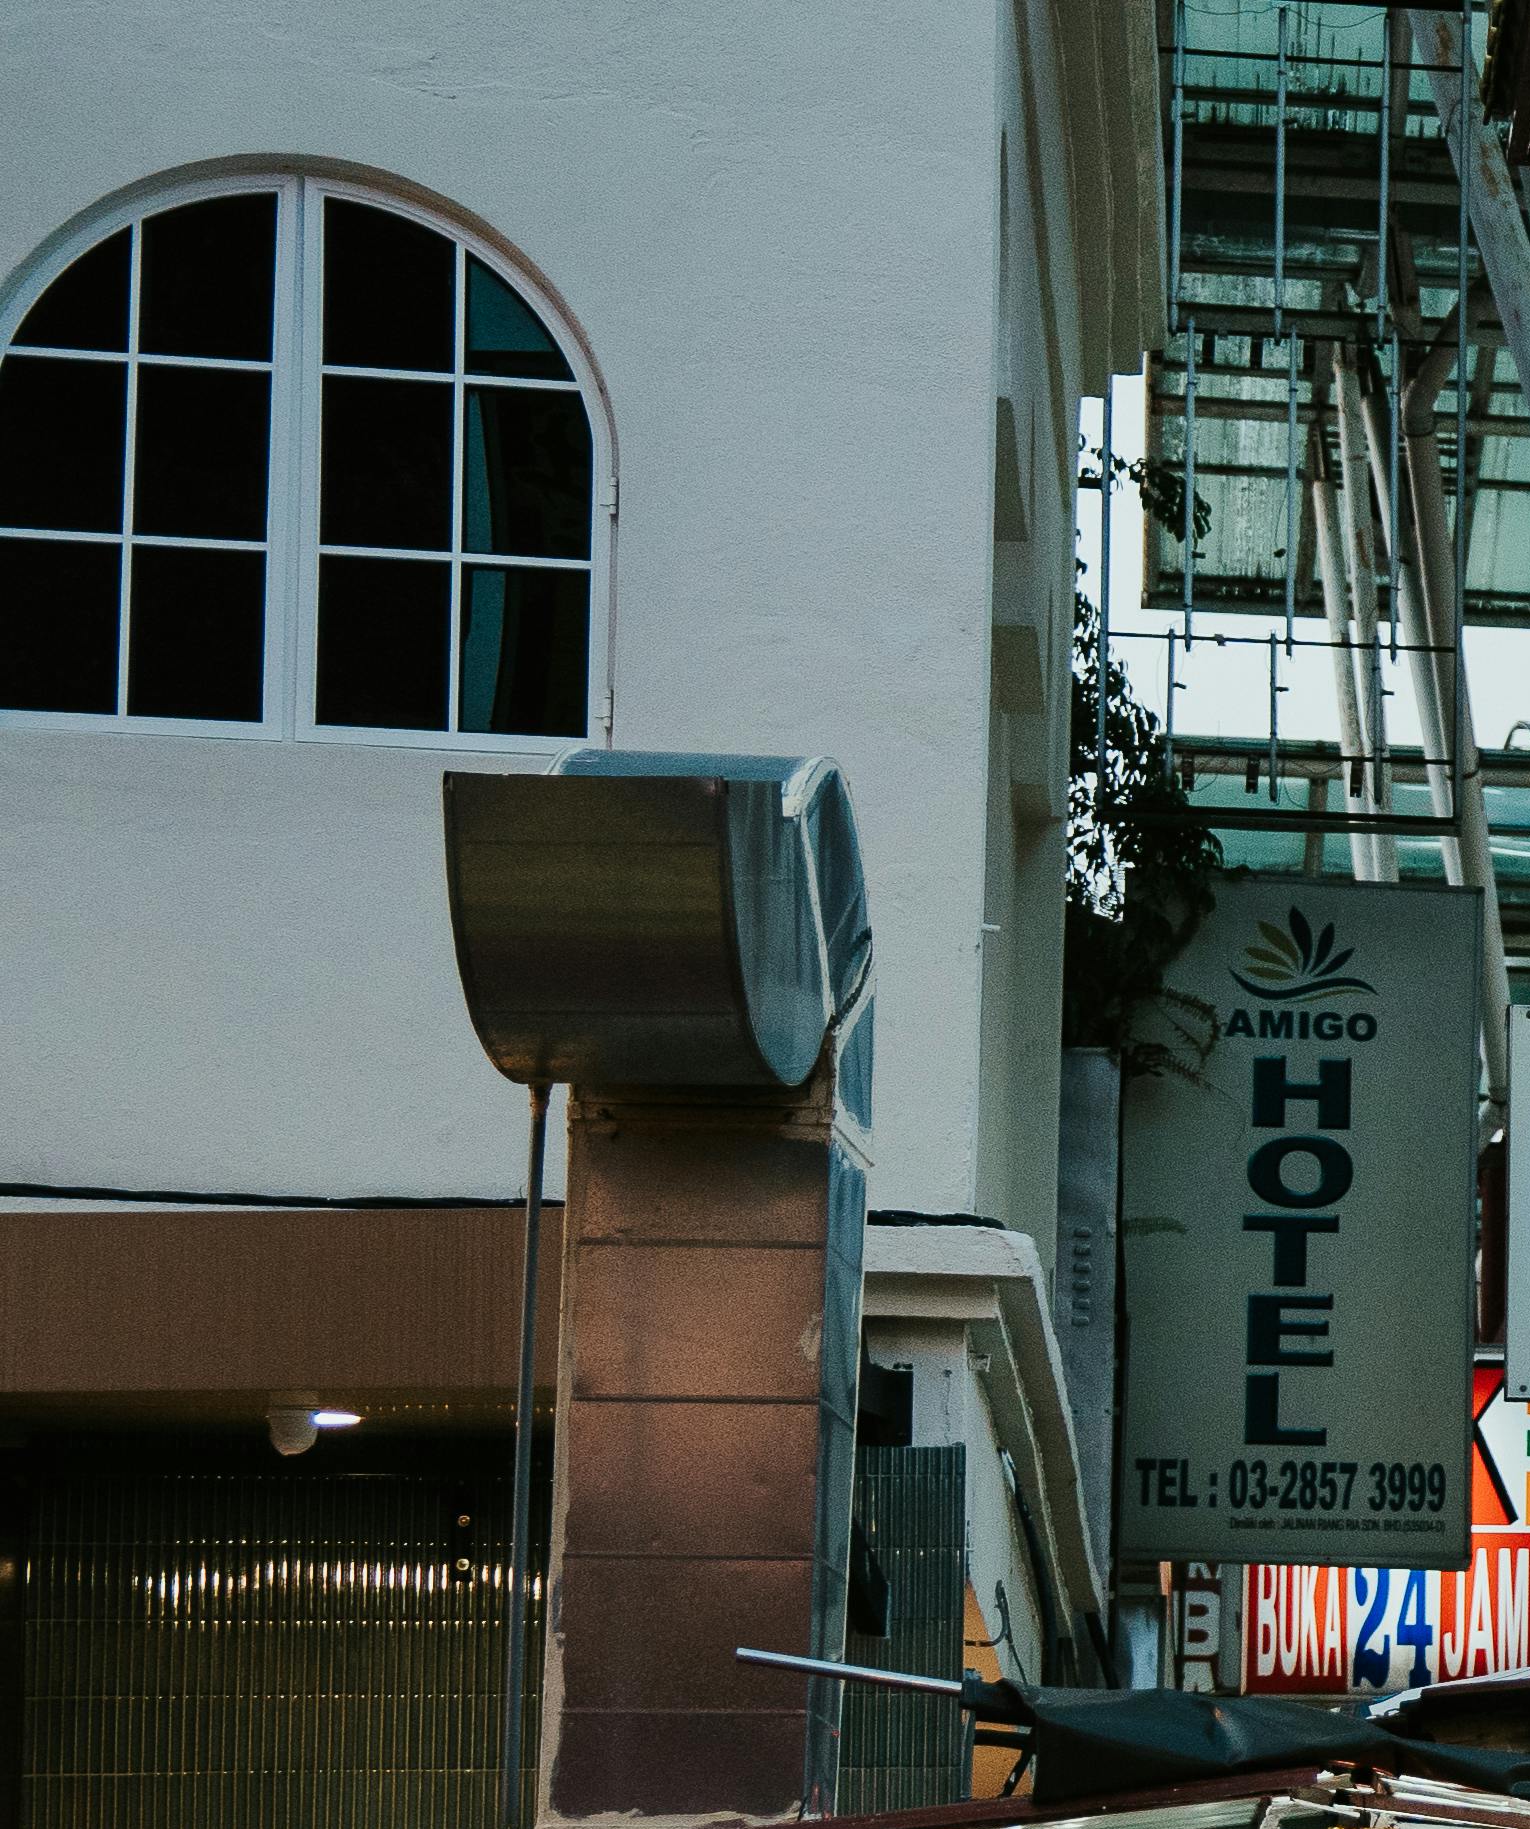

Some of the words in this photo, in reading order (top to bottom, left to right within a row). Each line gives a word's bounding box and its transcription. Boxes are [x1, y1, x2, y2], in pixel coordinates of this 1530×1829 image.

[1225, 1009, 1378, 1045] AMIGO
[1243, 1054, 1355, 1448] HOTEL
[1135, 1457, 1198, 1508] TEL
[1229, 1458, 1360, 1511] 03-2857
[1367, 1461, 1448, 1513] 3999
[1256, 1565, 1343, 1678] BUKA
[1353, 1566, 1433, 1689] 24
[1443, 1548, 1530, 1678] JAM
